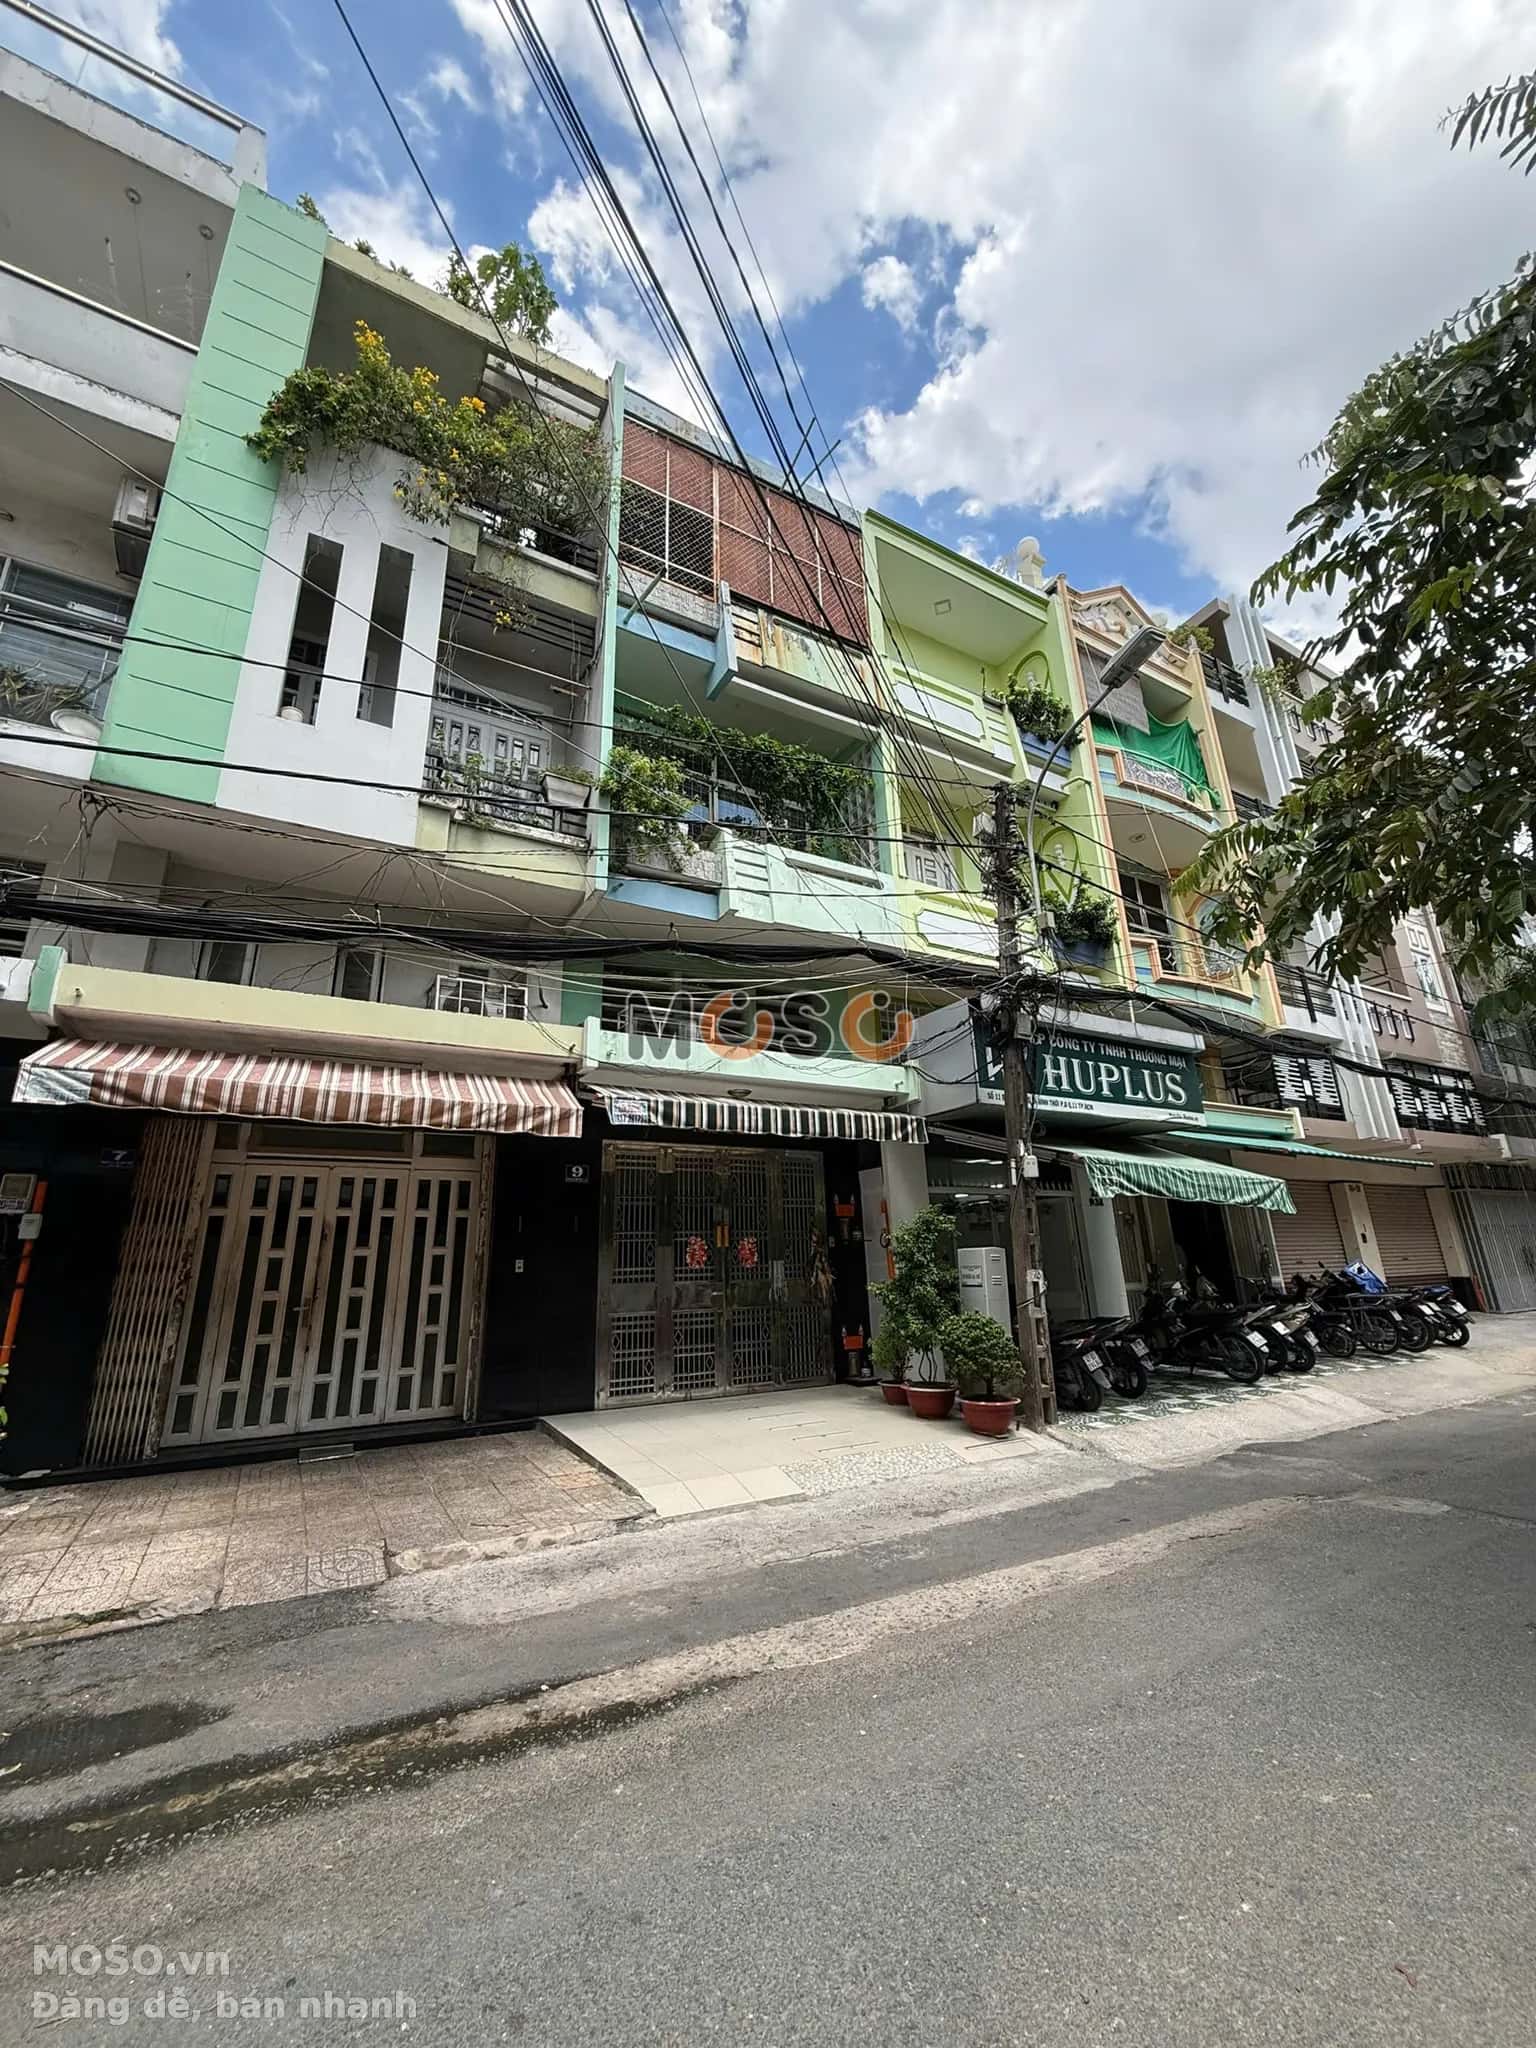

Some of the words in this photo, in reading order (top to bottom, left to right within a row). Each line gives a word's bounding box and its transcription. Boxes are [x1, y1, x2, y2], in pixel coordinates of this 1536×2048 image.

[1050, 1033, 1080, 1051] CÔNG
[1081, 1041, 1095, 1054] TY
[1098, 1043, 1127, 1059] TNHH
[1041, 1053, 1188, 1105] HUPLUS
[111, 1150, 128, 1161] 7
[572, 1166, 583, 1177] 9
